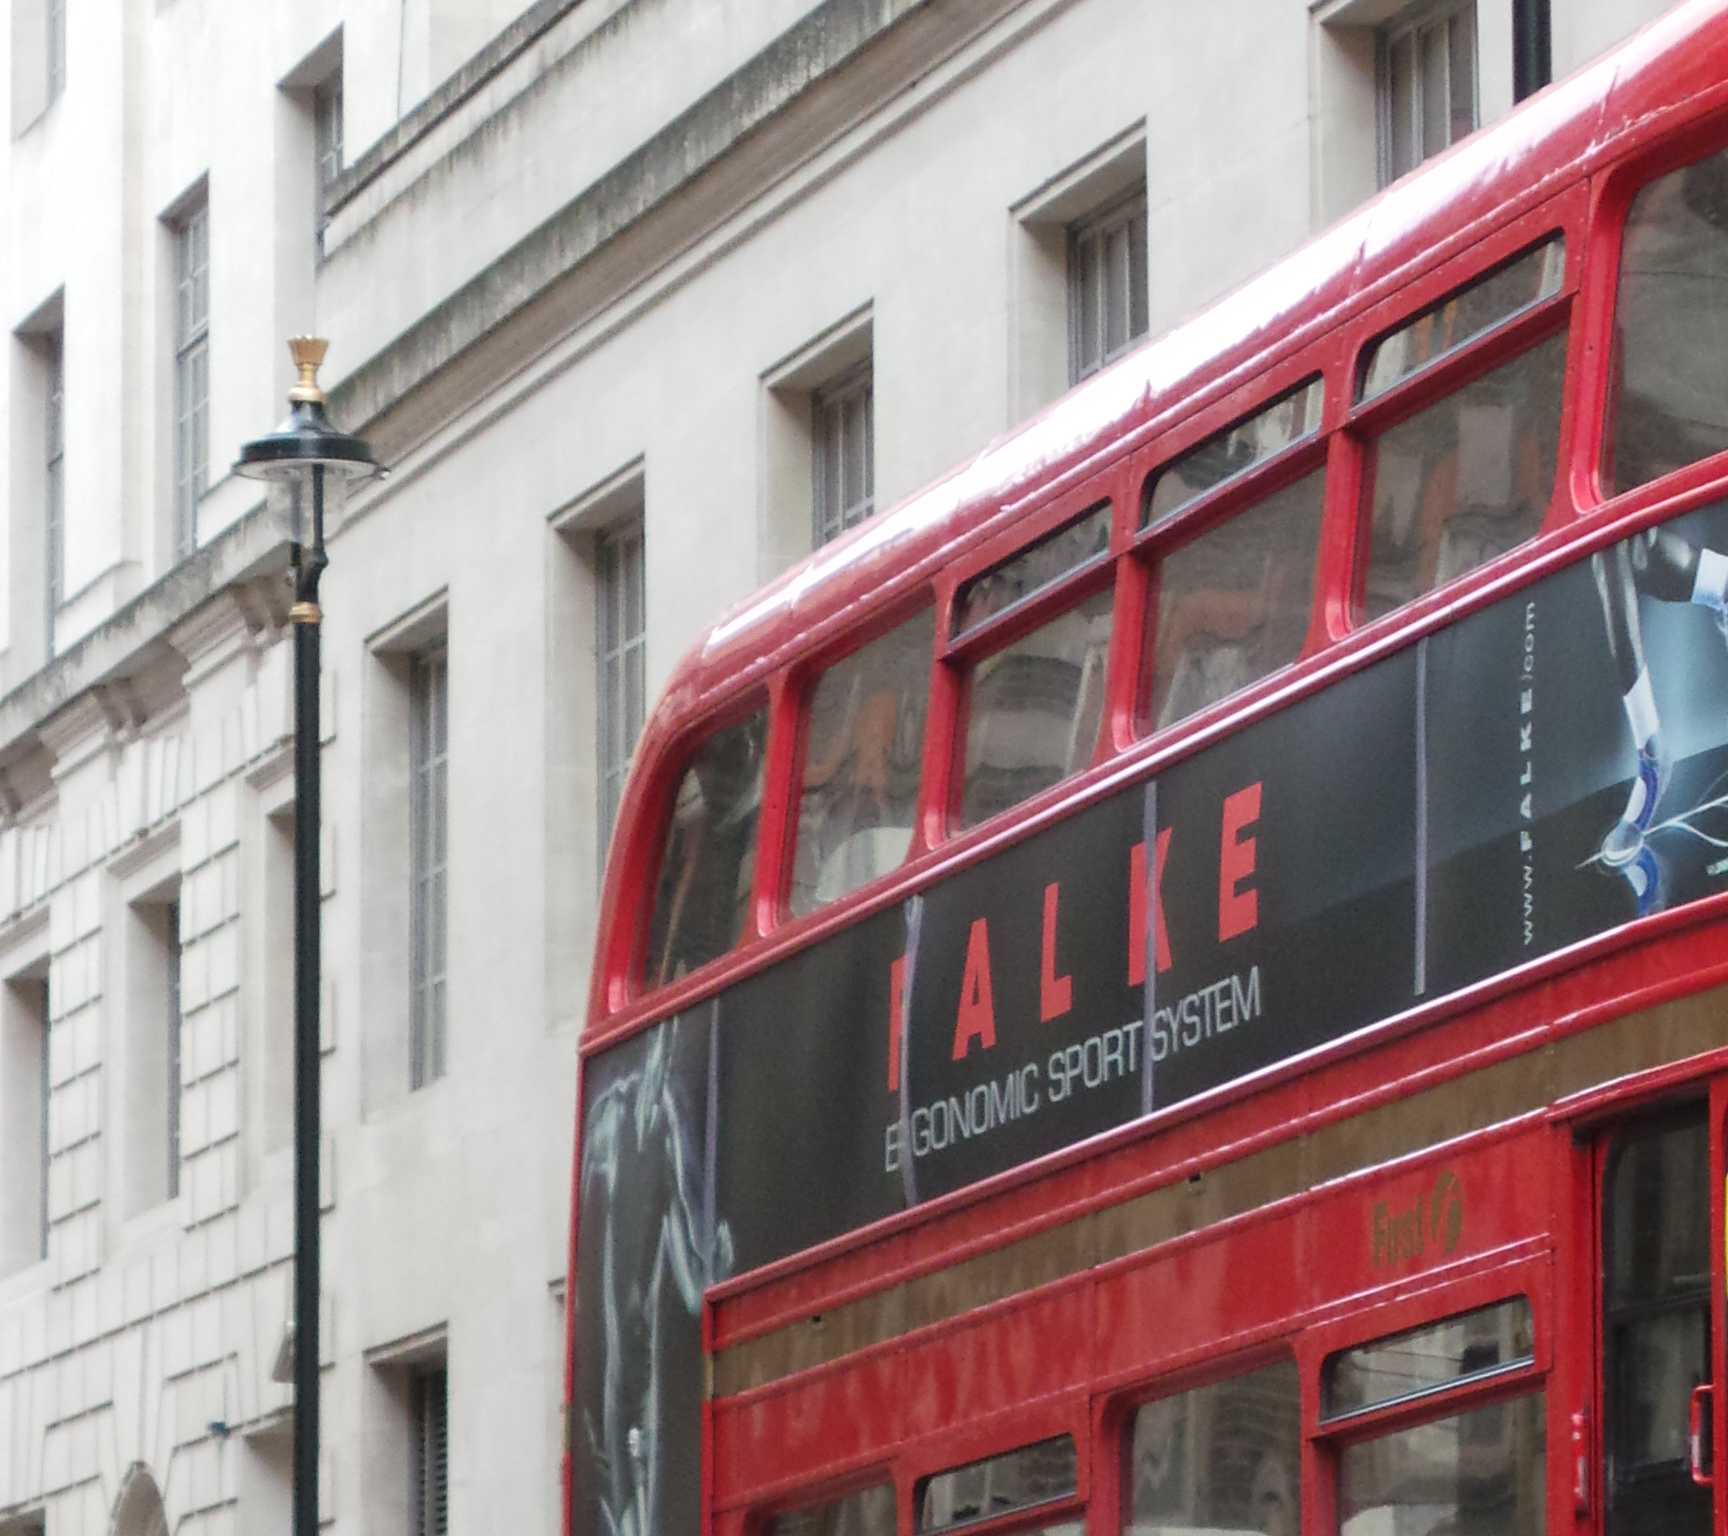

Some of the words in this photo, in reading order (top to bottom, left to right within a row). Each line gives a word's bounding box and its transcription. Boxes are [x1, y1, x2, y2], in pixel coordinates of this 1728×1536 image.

[884, 1061, 1039, 1172] EGONOMIC
[1047, 1020, 1144, 1104] SPORT
[1152, 965, 1262, 1063] SYSTEM
[1372, 1193, 1425, 1269] First
